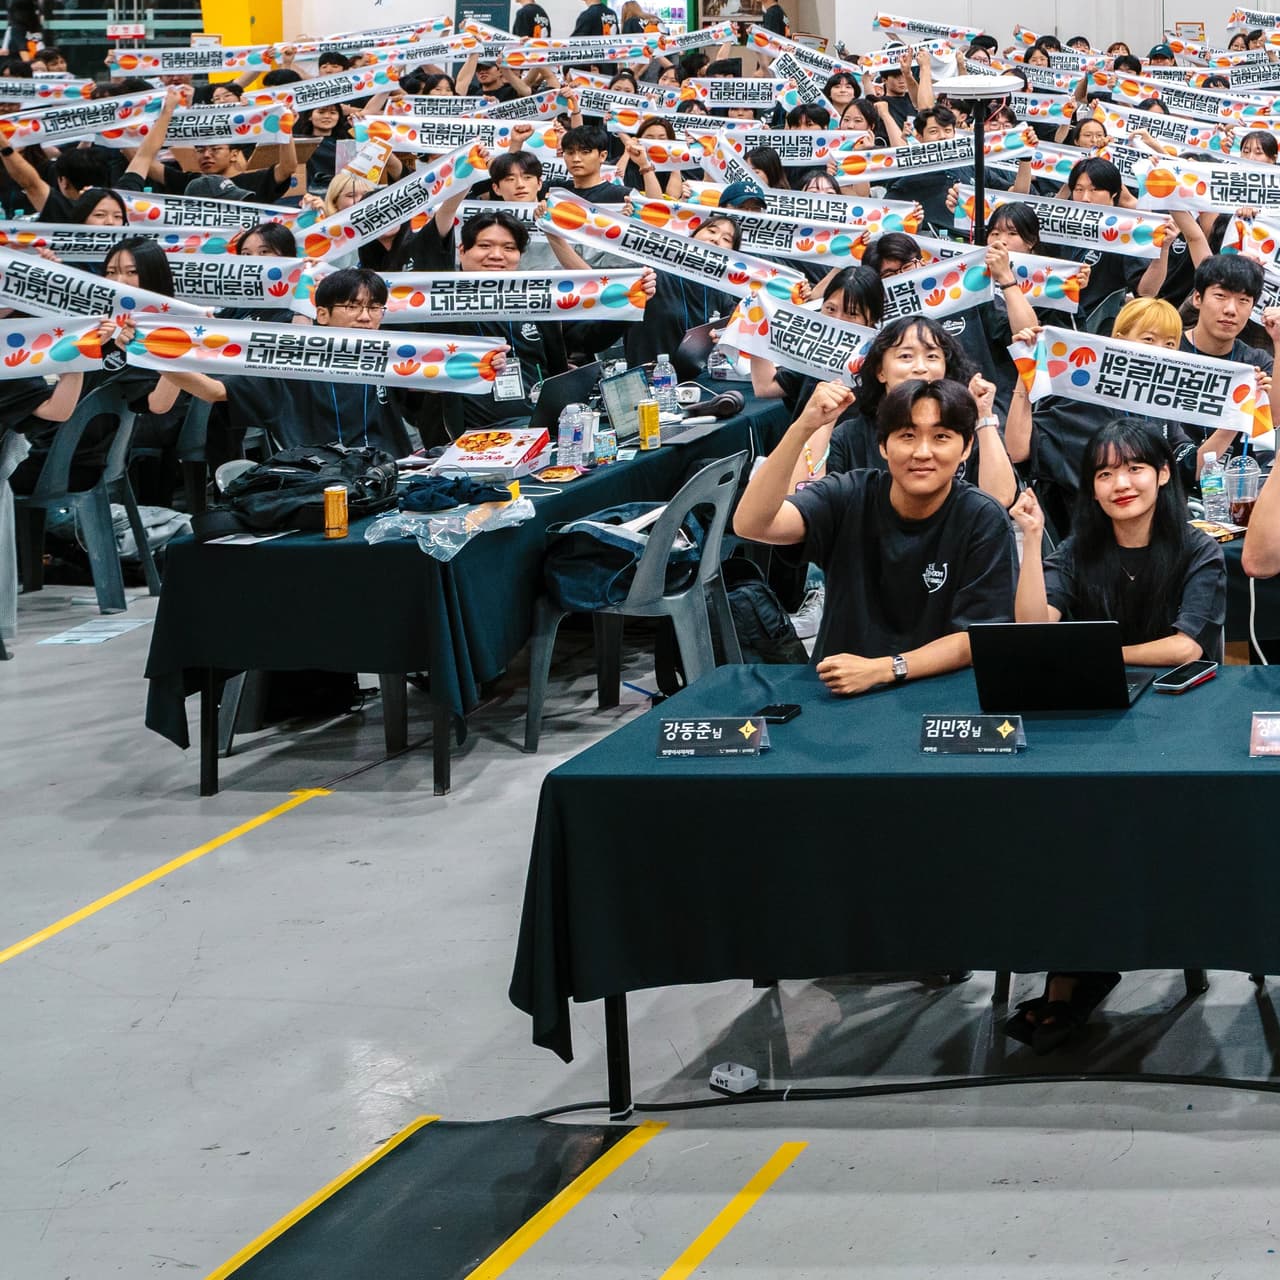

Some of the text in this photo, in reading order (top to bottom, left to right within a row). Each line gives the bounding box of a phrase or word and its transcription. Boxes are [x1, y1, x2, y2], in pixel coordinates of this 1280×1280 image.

[293, 76, 351, 97] 모험의시작
[295, 84, 353, 106] 네멋대로해
[710, 82, 773, 92] 모험의시작
[710, 90, 773, 102] 네멋대로해
[1162, 87, 1221, 106] 모험의시작
[1160, 94, 1219, 115] 네멋대로해
[168, 114, 230, 127] 험의시작
[420, 122, 496, 137] 모험의시작
[1128, 113, 1188, 133] 모험의시작
[745, 135, 812, 148] 모험의시작
[895, 136, 972, 159] 모험의시작
[897, 148, 974, 167] 네멋대로해
[164, 199, 259, 216] 모험의시작
[350, 177, 422, 225] 모험의시작
[357, 188, 430, 237] 네멋대로해
[621, 233, 727, 278] 네멋대로해
[7, 261, 116, 305] 모험의시작
[430, 280, 551, 295] 모험의시작
[2, 276, 114, 318] 네멋대로해
[430, 293, 551, 311] 네멋대로해
[771, 309, 860, 351] 모험의시작
[250, 332, 391, 357] 모험의시작
[770, 326, 851, 369] 네멋대로해
[246, 347, 389, 377] 네멋대로해
[1099, 353, 1231, 388] 네멋대로해
[1095, 382, 1222, 416] 모험의시작
